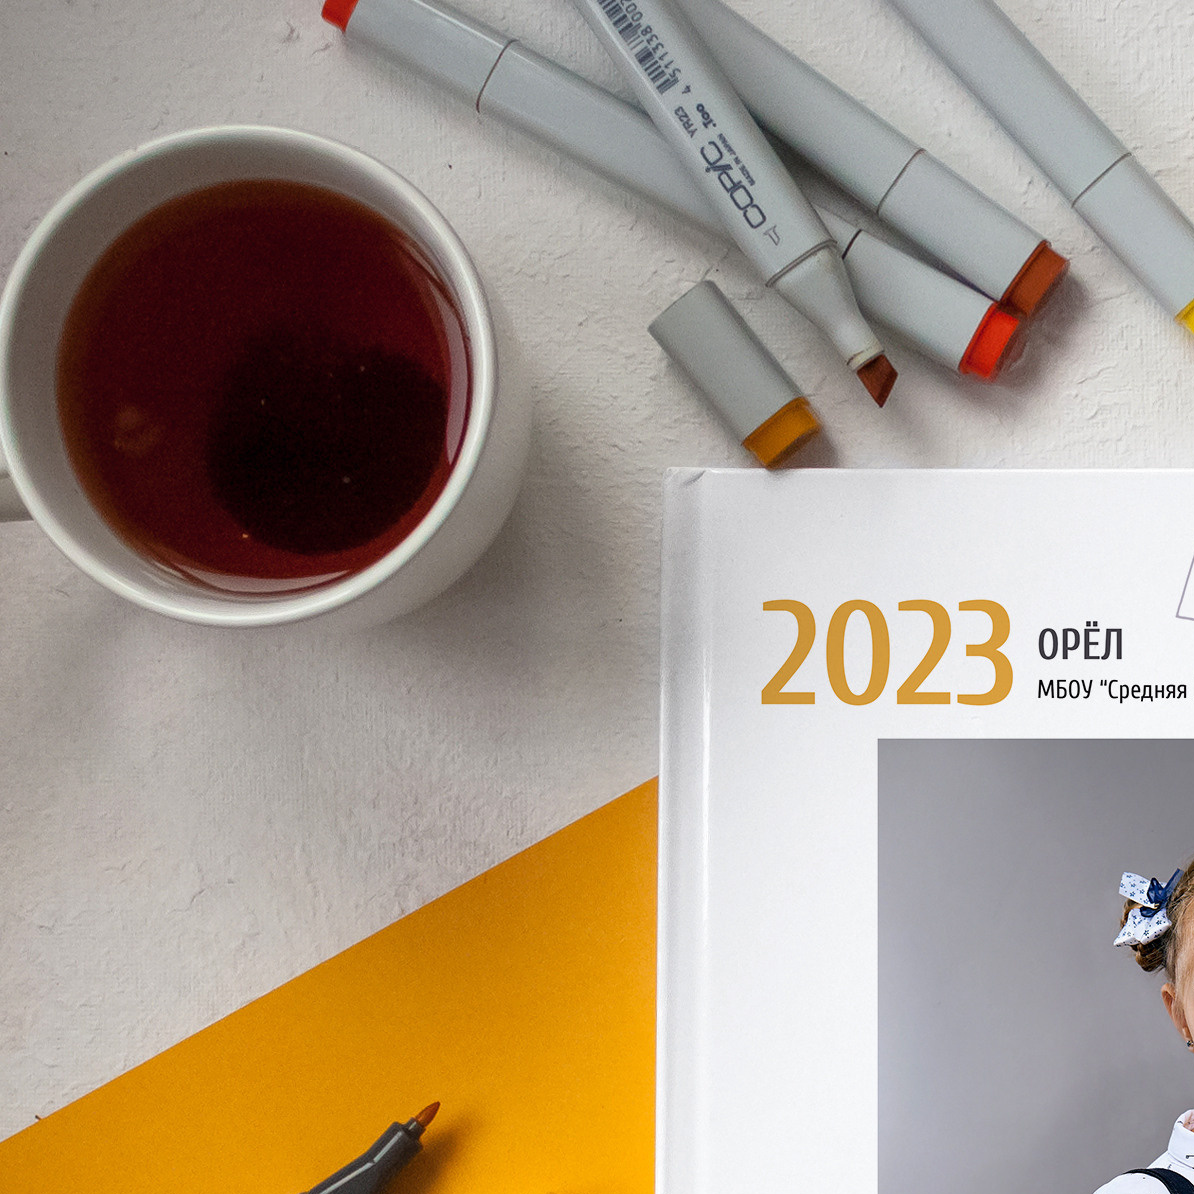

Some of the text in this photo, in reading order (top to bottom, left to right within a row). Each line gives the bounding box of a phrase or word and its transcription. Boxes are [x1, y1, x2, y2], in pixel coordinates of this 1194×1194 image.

[681, 85, 691, 95] 4
[674, 105, 698, 138] YR23
[761, 599, 1013, 706] 2023
[1038, 621, 1122, 660] ОРЁЛ
[1037, 679, 1093, 699] МБОУ
